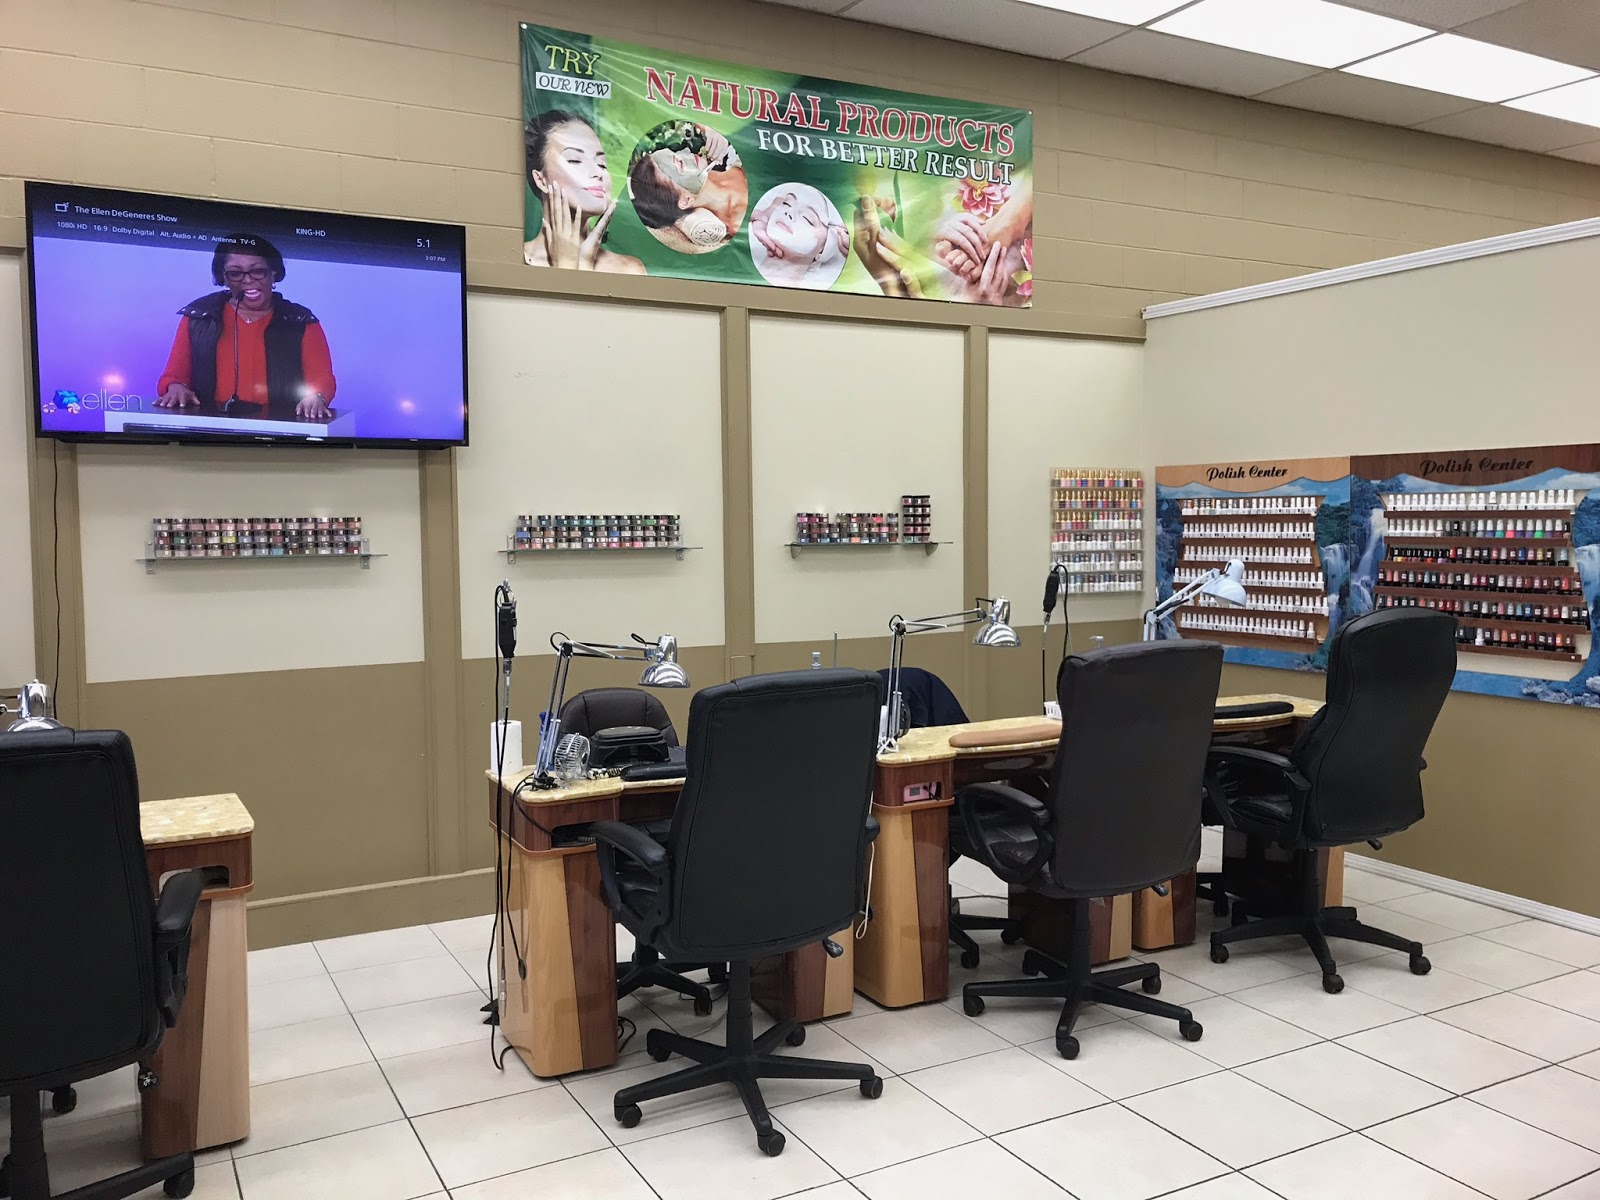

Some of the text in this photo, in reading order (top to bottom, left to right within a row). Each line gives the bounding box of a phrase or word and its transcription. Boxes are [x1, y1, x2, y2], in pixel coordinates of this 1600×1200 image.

[544, 44, 600, 76] TRY
[538, 75, 609, 97] OUR NEW
[644, 66, 1015, 156] NATURAL PRODUCTS
[756, 128, 1015, 186] FOR BETTER RESULT
[74, 205, 178, 223] The Ellen DeGeneres Show
[112, 226, 132, 235] Dolby
[132, 228, 155, 237] Digital
[172, 232, 192, 240] Audio
[211, 235, 237, 244] Antenna
[240, 238, 256, 246] TV-G
[295, 227, 326, 238] KING-HD
[416, 238, 430, 248] 5.1
[81, 388, 143, 412] ellen
[1206, 465, 1288, 481] Polish Center
[1419, 457, 1534, 477] Polish Center
